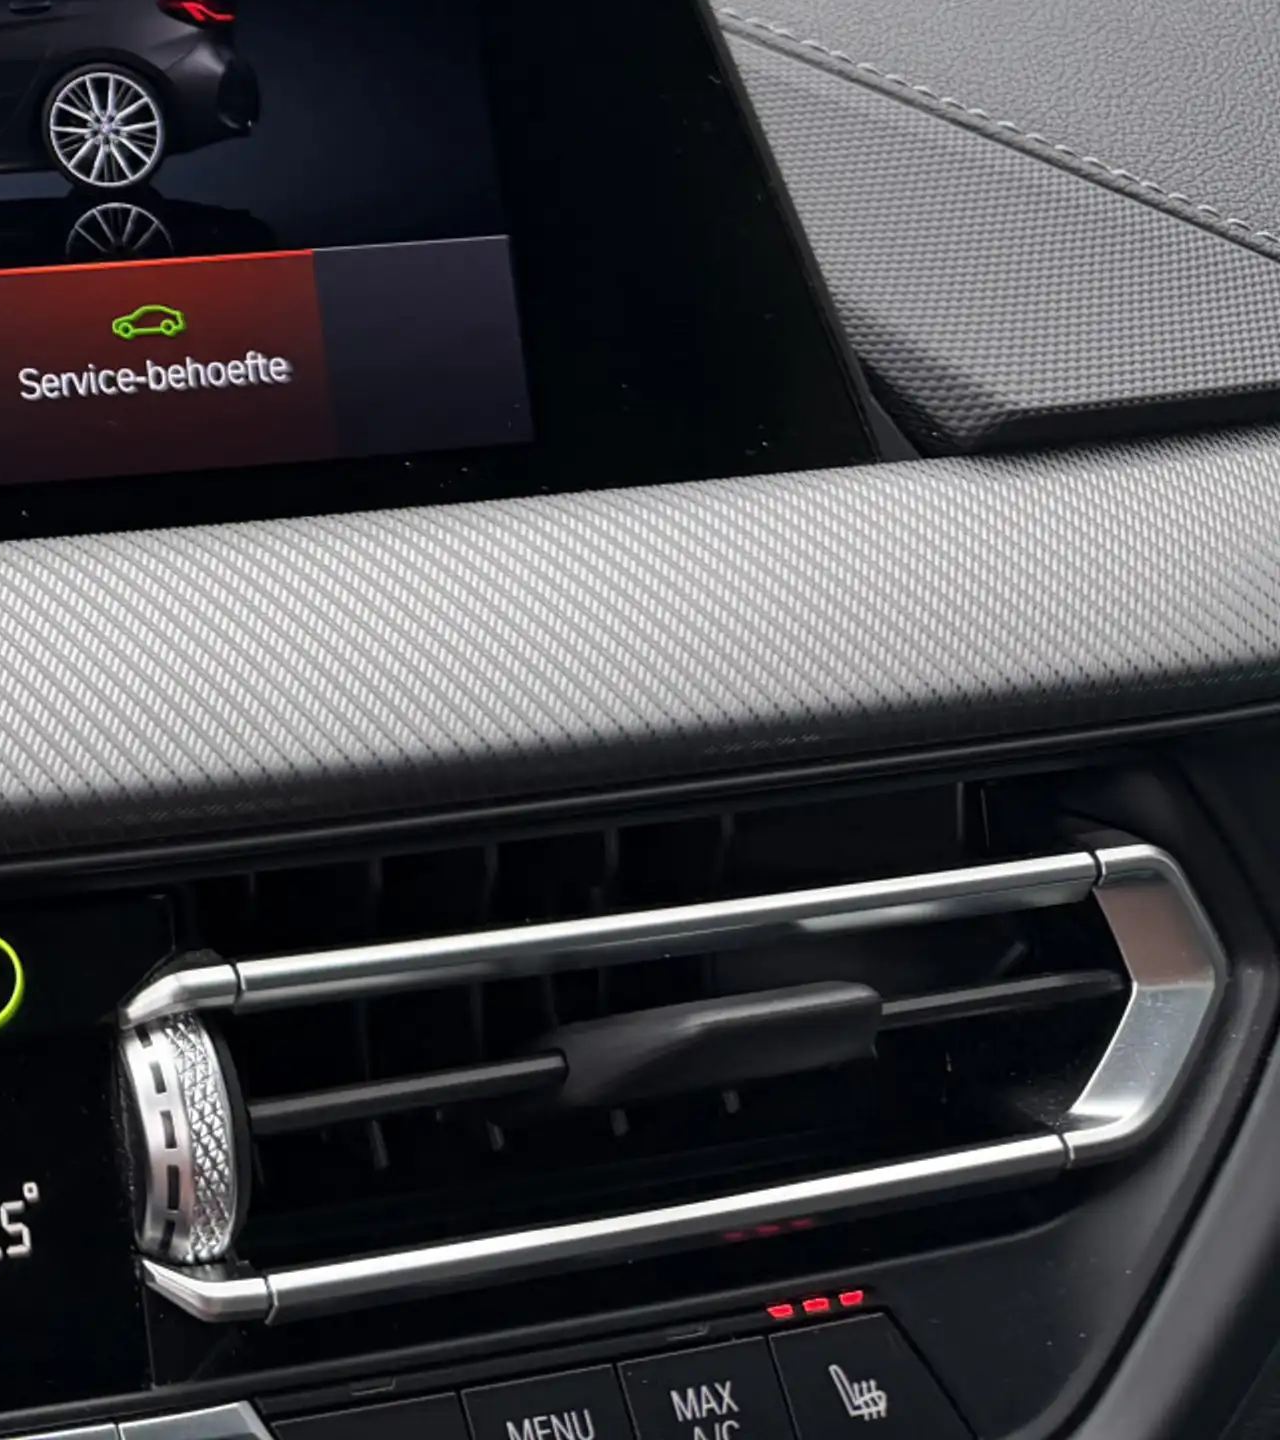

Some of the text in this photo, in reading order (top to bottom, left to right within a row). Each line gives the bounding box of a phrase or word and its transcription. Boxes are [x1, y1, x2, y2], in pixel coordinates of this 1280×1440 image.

[17, 351, 292, 401] Service-behoefte
[670, 1379, 740, 1423] MAX
[506, 1409, 596, 1440] MENU
